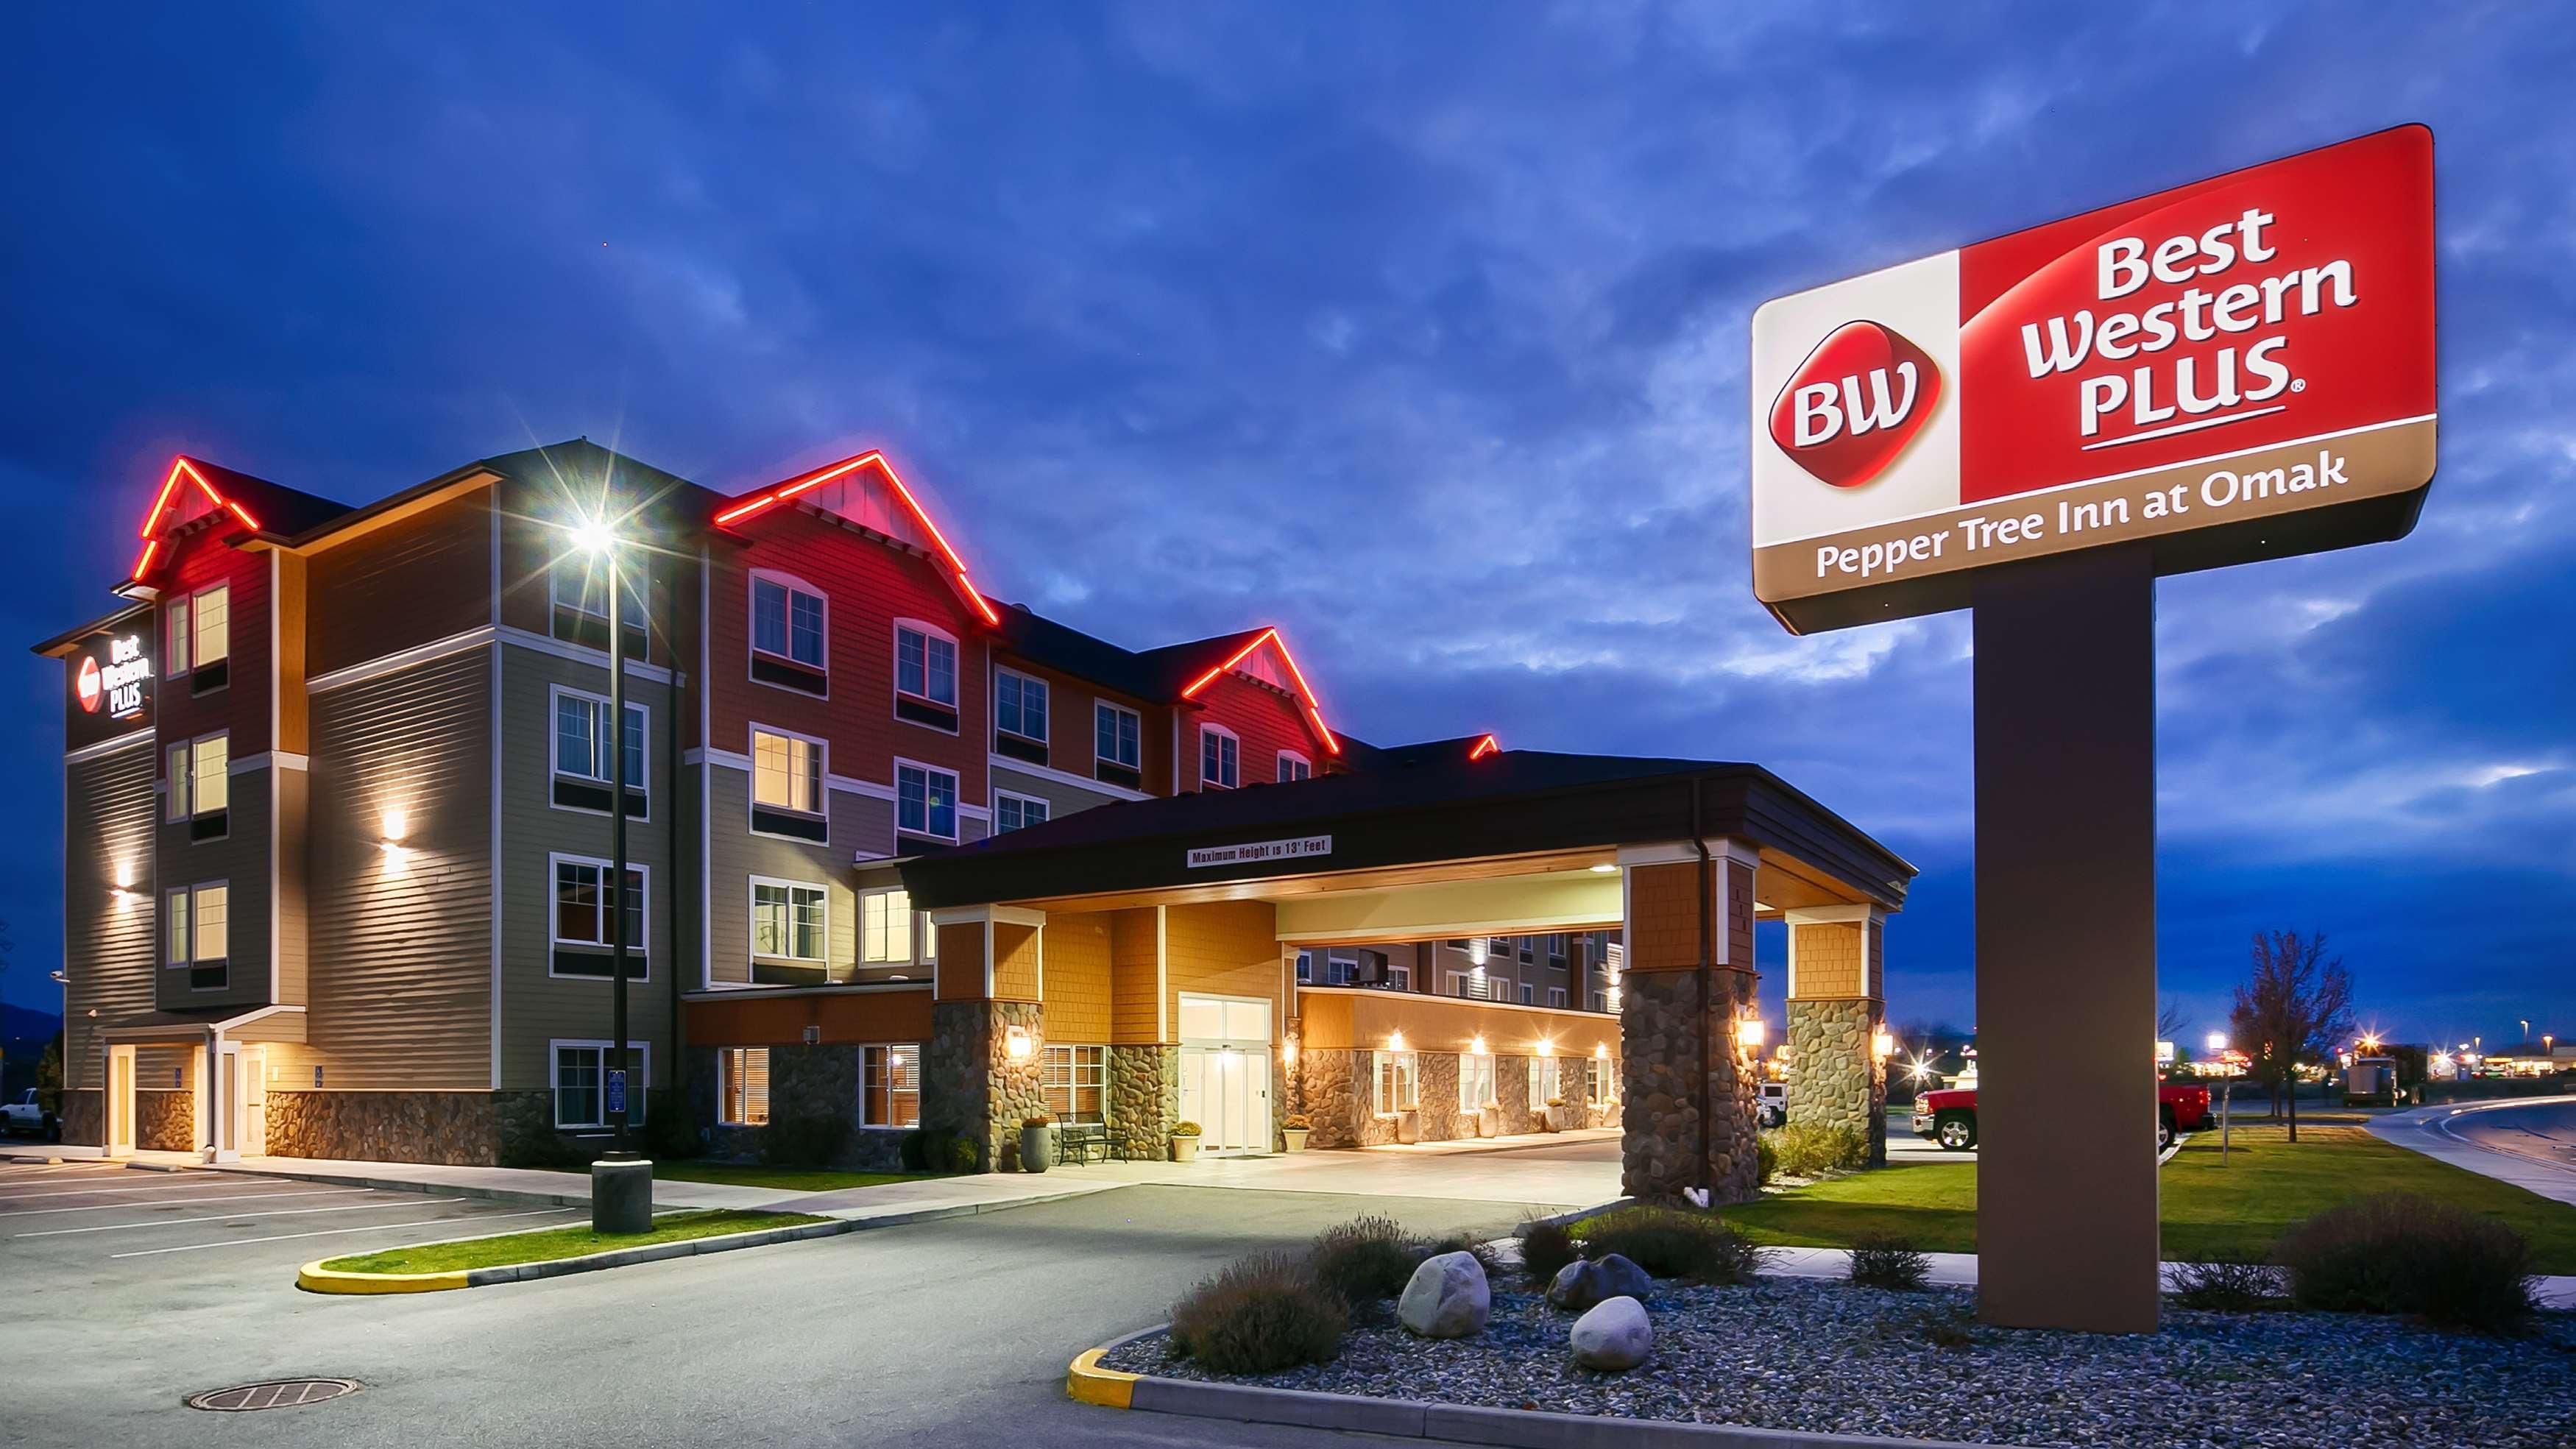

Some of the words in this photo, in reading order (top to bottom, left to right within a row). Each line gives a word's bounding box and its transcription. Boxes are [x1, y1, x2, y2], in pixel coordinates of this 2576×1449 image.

[2098, 208, 2276, 300] Best
[2021, 260, 2357, 378] Western
[1794, 361, 1917, 447] BW
[1817, 530, 1950, 578] Pepper
[1958, 514, 2044, 551] Tree
[2059, 497, 2130, 534] Inn
[2142, 483, 2190, 519] at
[2201, 450, 2349, 507] Omak
[110, 682, 141, 712] PLUS
[1192, 849, 1236, 863] Maximum
[1239, 845, 1269, 860] Height
[1303, 840, 1326, 852] Feet
